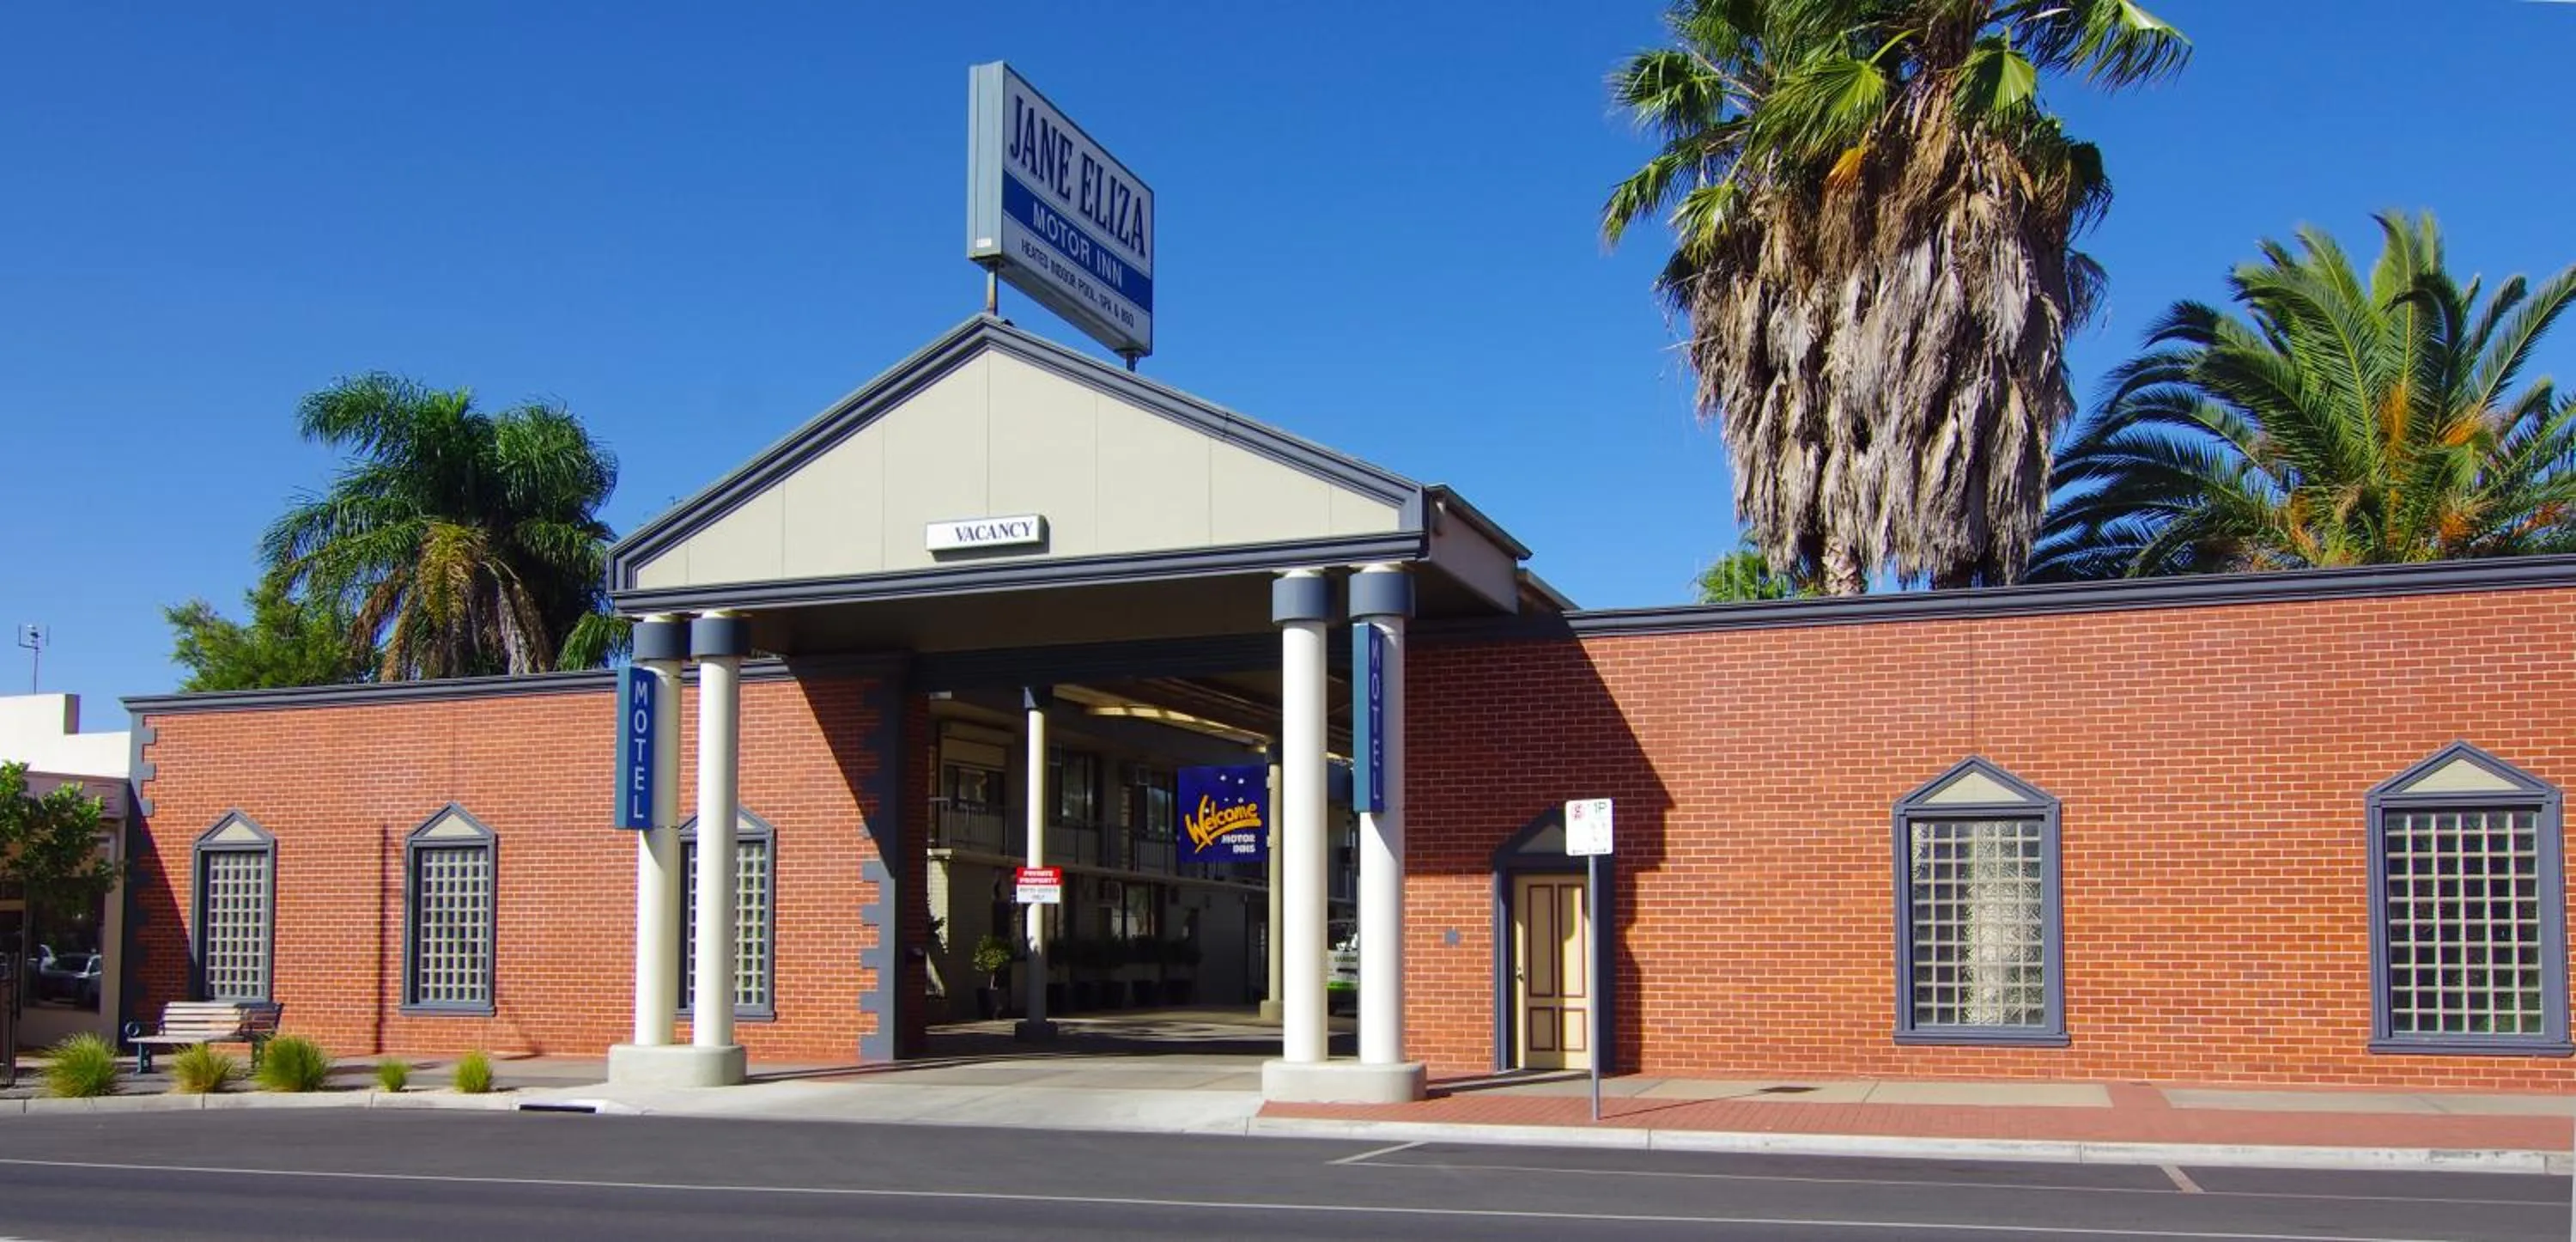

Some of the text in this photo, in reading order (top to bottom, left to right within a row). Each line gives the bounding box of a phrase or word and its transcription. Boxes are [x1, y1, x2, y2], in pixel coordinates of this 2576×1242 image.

[1009, 94, 1146, 258] JANE ELIZA
[1020, 238, 1049, 269] HEATED
[1032, 201, 1124, 289] MOTOR INN
[955, 521, 1032, 542] VACANCY
[634, 680, 648, 819] MOTEL
[1371, 637, 1381, 801] MOTEL
[1184, 794, 1261, 849] Welcome
[1220, 834, 1256, 844] MOTOR
